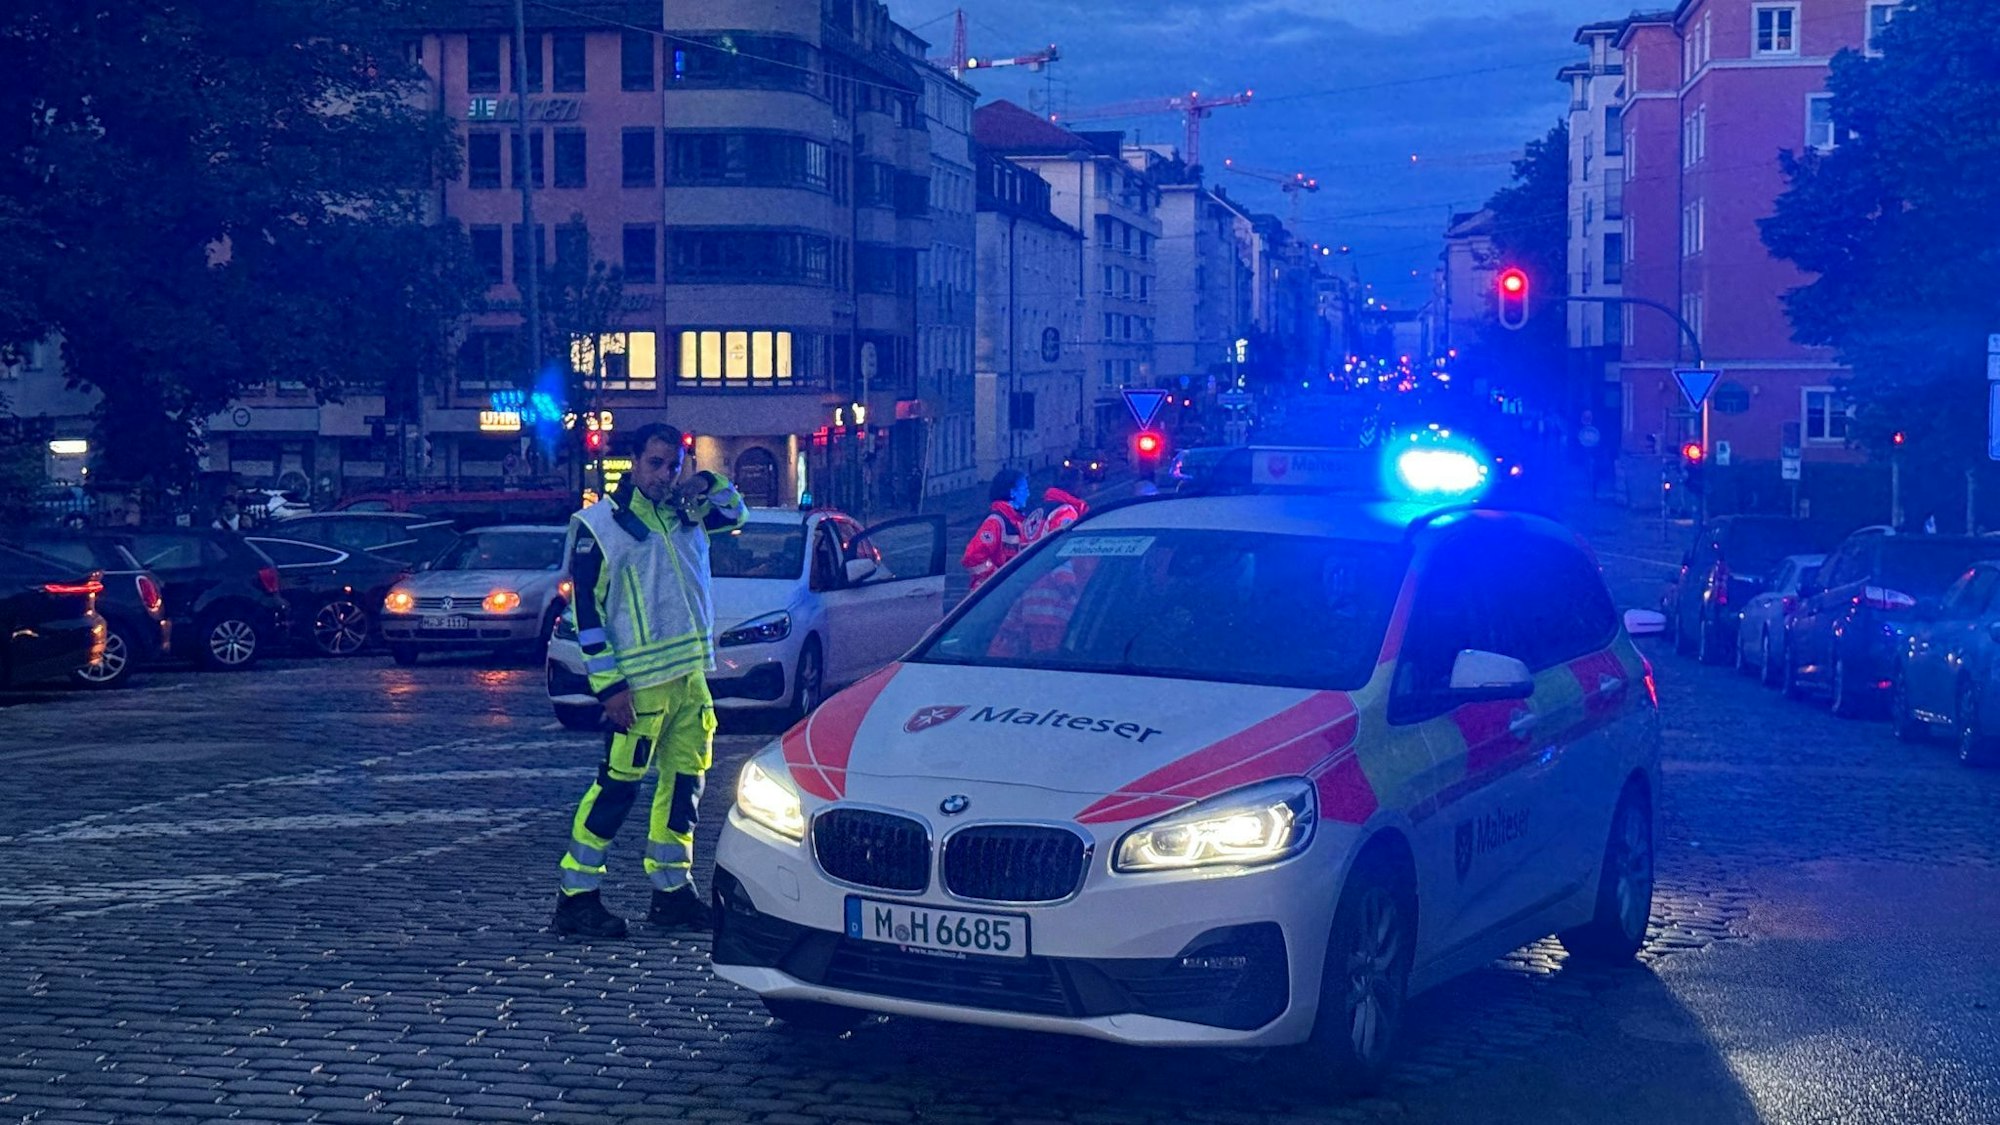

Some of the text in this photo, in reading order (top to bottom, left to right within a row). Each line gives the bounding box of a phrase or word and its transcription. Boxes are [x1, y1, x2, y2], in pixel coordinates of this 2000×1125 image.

[1292, 455, 1355, 473] Maltese
[969, 706, 1163, 743] Malteser
[1478, 807, 1530, 854] Malteser
[875, 906, 1012, 951] M H 6685
